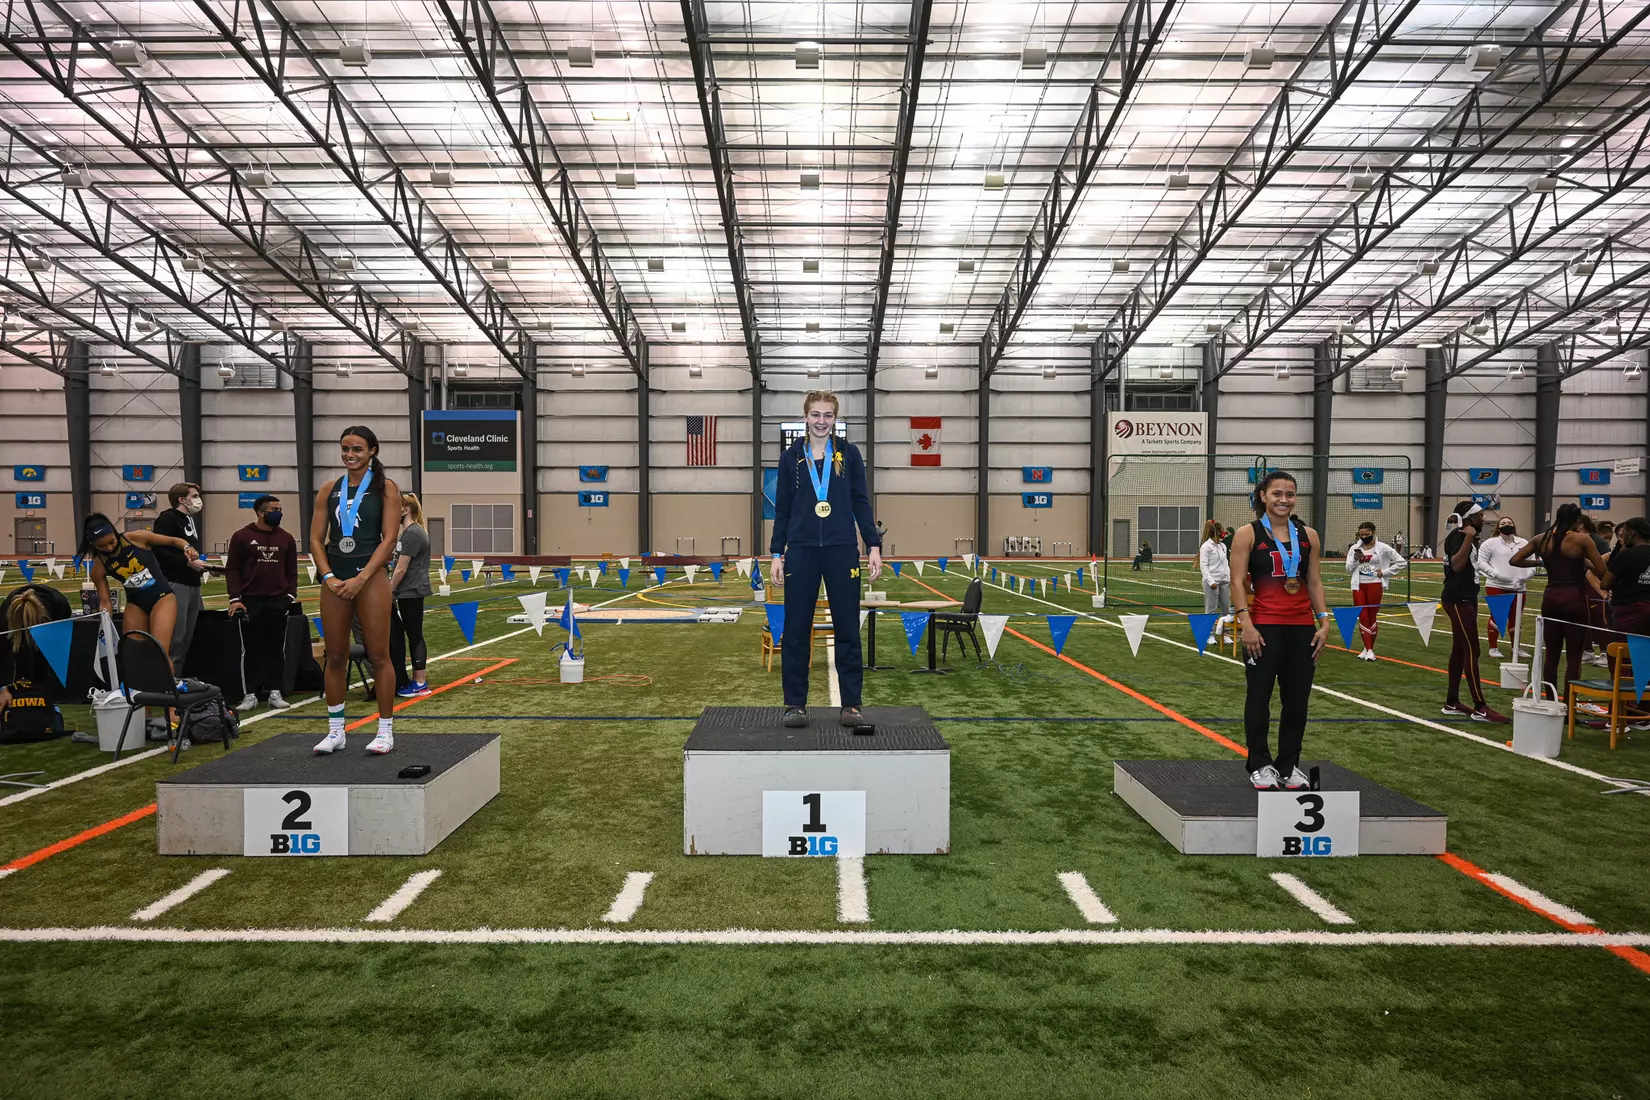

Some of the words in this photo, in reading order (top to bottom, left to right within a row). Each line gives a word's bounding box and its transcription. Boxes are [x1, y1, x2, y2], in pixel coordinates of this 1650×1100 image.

[1135, 422, 1202, 436] BEYNON
[446, 434, 485, 443] Cleveland
[486, 434, 509, 443] Clinic
[246, 467, 260, 478] M
[1032, 469, 1043, 480] N
[1478, 472, 1492, 480] P
[1589, 471, 1600, 481] R
[850, 567, 860, 578] M
[11, 697, 46, 708] IOWA
[281, 790, 312, 830] 2
[802, 793, 826, 832] 1
[1293, 794, 1325, 833] 3
